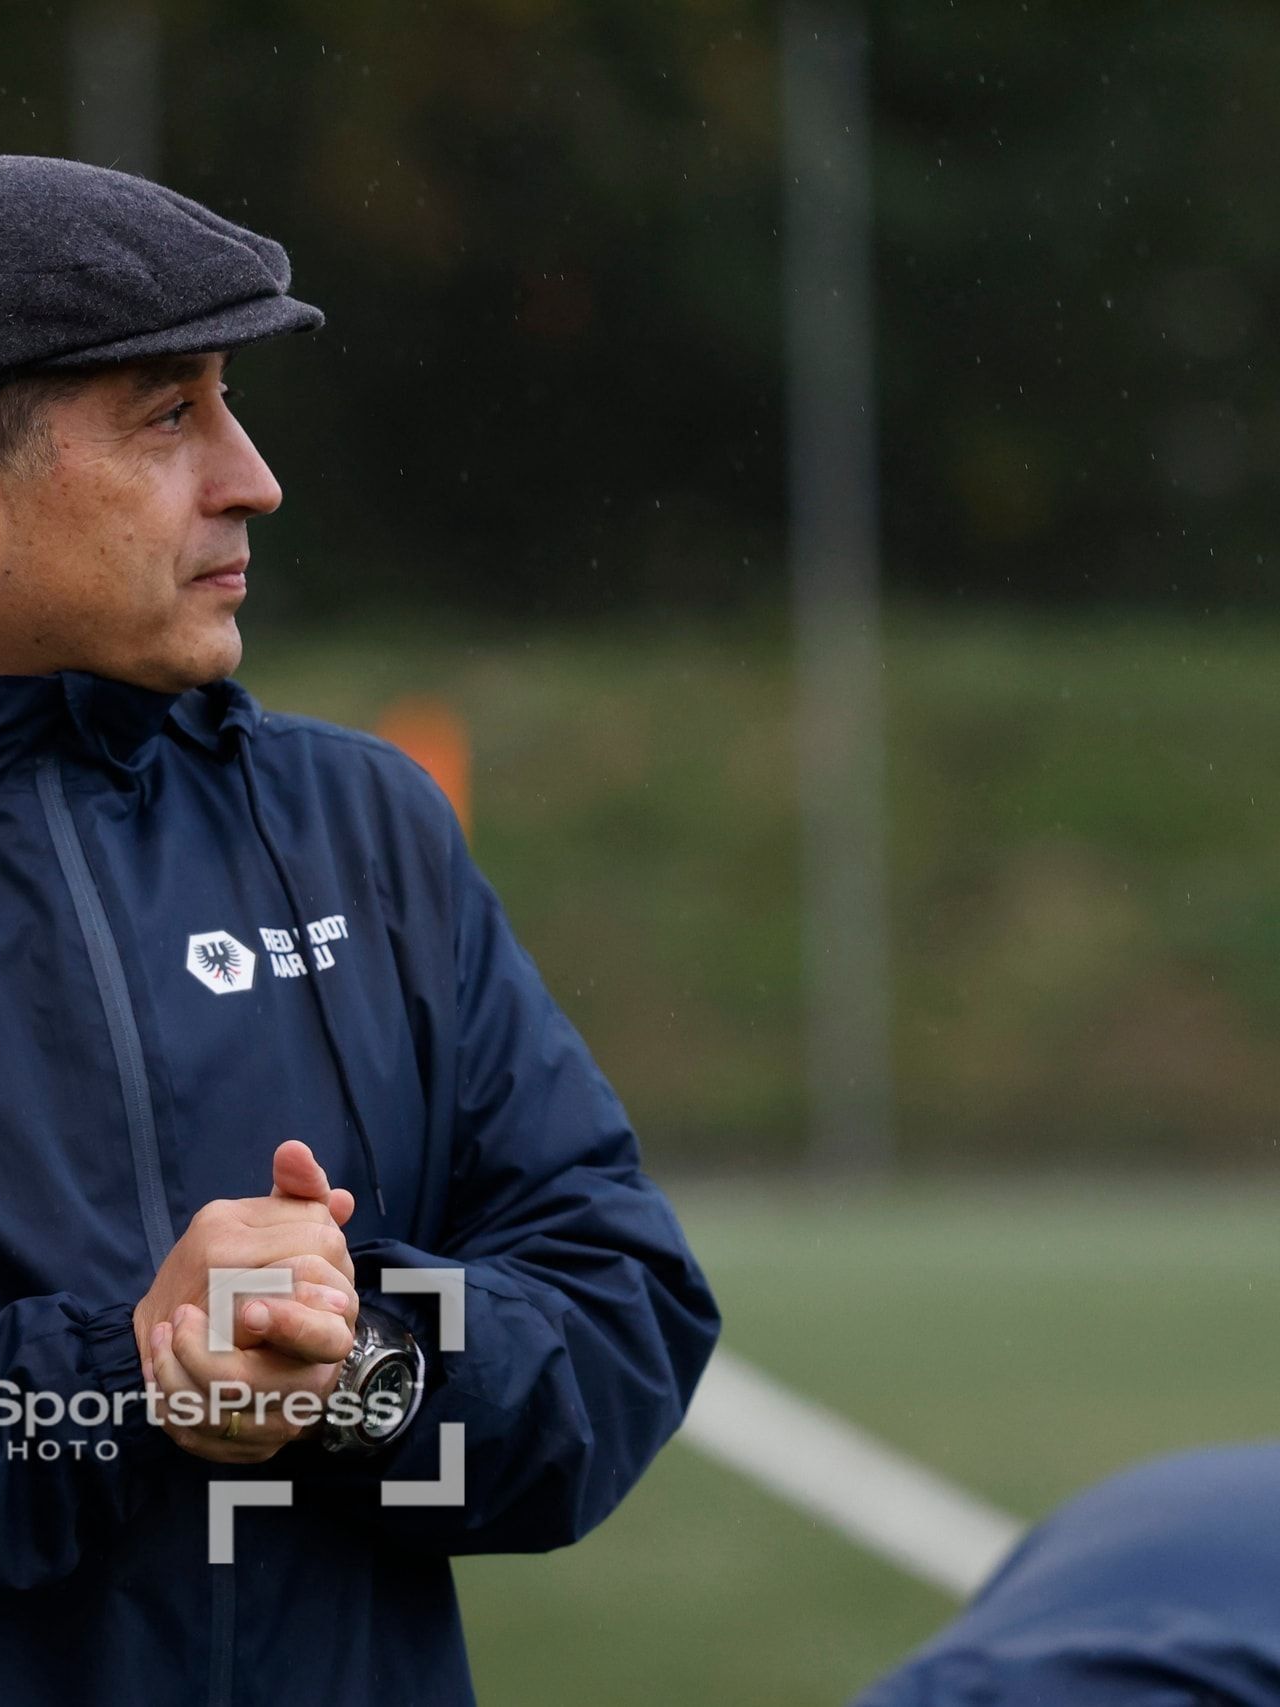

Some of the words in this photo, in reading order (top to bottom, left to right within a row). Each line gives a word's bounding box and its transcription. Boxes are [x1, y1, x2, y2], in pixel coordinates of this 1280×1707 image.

[259, 927, 295, 953] RED
[292, 914, 349, 945] OOT
[269, 944, 336, 978] AARU
